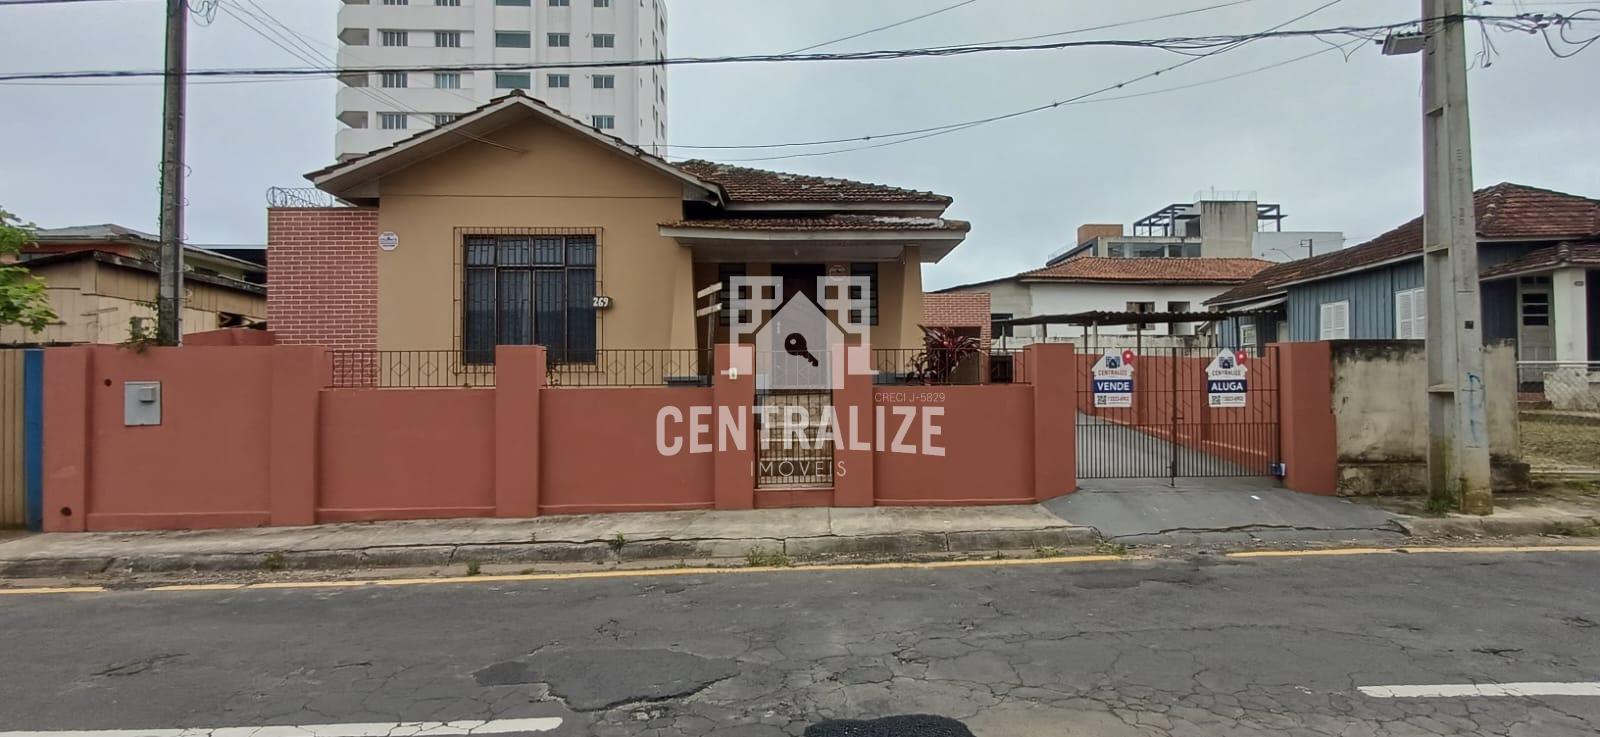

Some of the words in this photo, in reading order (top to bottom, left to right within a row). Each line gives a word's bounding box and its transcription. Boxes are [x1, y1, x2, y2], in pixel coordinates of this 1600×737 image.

[592, 296, 609, 307] 269
[1096, 381, 1130, 391] VENDE
[1211, 381, 1244, 391] ALUGA
